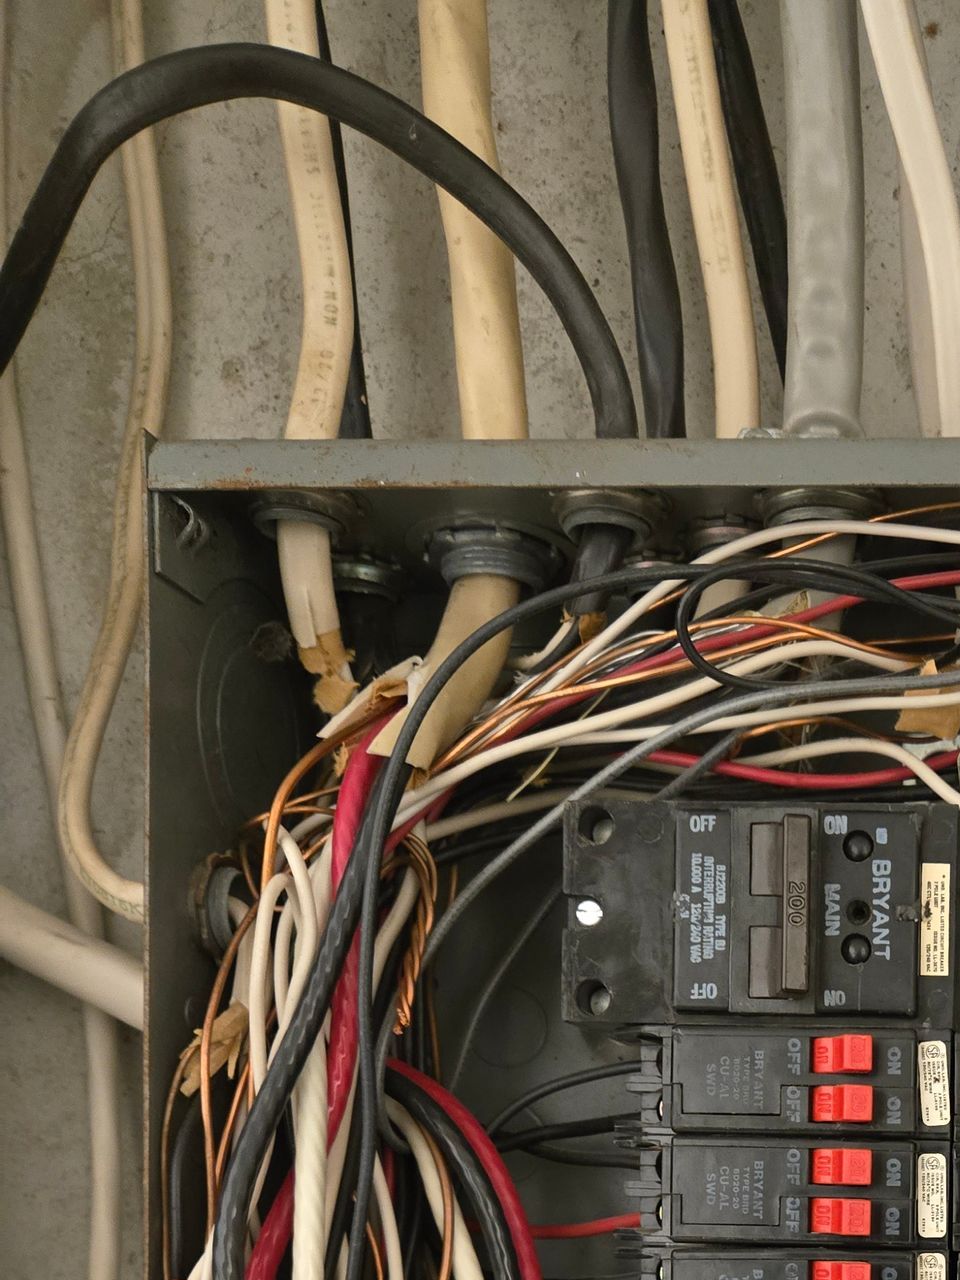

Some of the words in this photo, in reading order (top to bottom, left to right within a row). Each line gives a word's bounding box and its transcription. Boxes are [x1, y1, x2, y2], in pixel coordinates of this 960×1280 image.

[689, 815, 716, 832] OFF
[824, 815, 848, 835] ON
[703, 856, 714, 923] INTERRUPTING
[787, 881, 805, 927] 200
[715, 914, 726, 937] TYPE
[824, 884, 840, 936] MAIN
[872, 859, 892, 960] BRYANT
[690, 945, 701, 963] VAC
[703, 926, 714, 959] RATING
[715, 940, 725, 951] BJ
[690, 983, 718, 999] OFF
[823, 990, 846, 1006] ON
[787, 1038, 801, 1075] OFF
[887, 1047, 901, 1075] ON
[706, 1064, 716, 1096] SWD
[754, 1050, 764, 1109] BRYANT
[787, 1086, 801, 1122] OFF
[886, 1096, 901, 1124] ON
[787, 1149, 801, 1185] OFF
[886, 1158, 901, 1186] ON
[706, 1173, 715, 1205] SWD
[753, 1161, 764, 1219] BRYANT
[885, 1207, 900, 1235] ON
